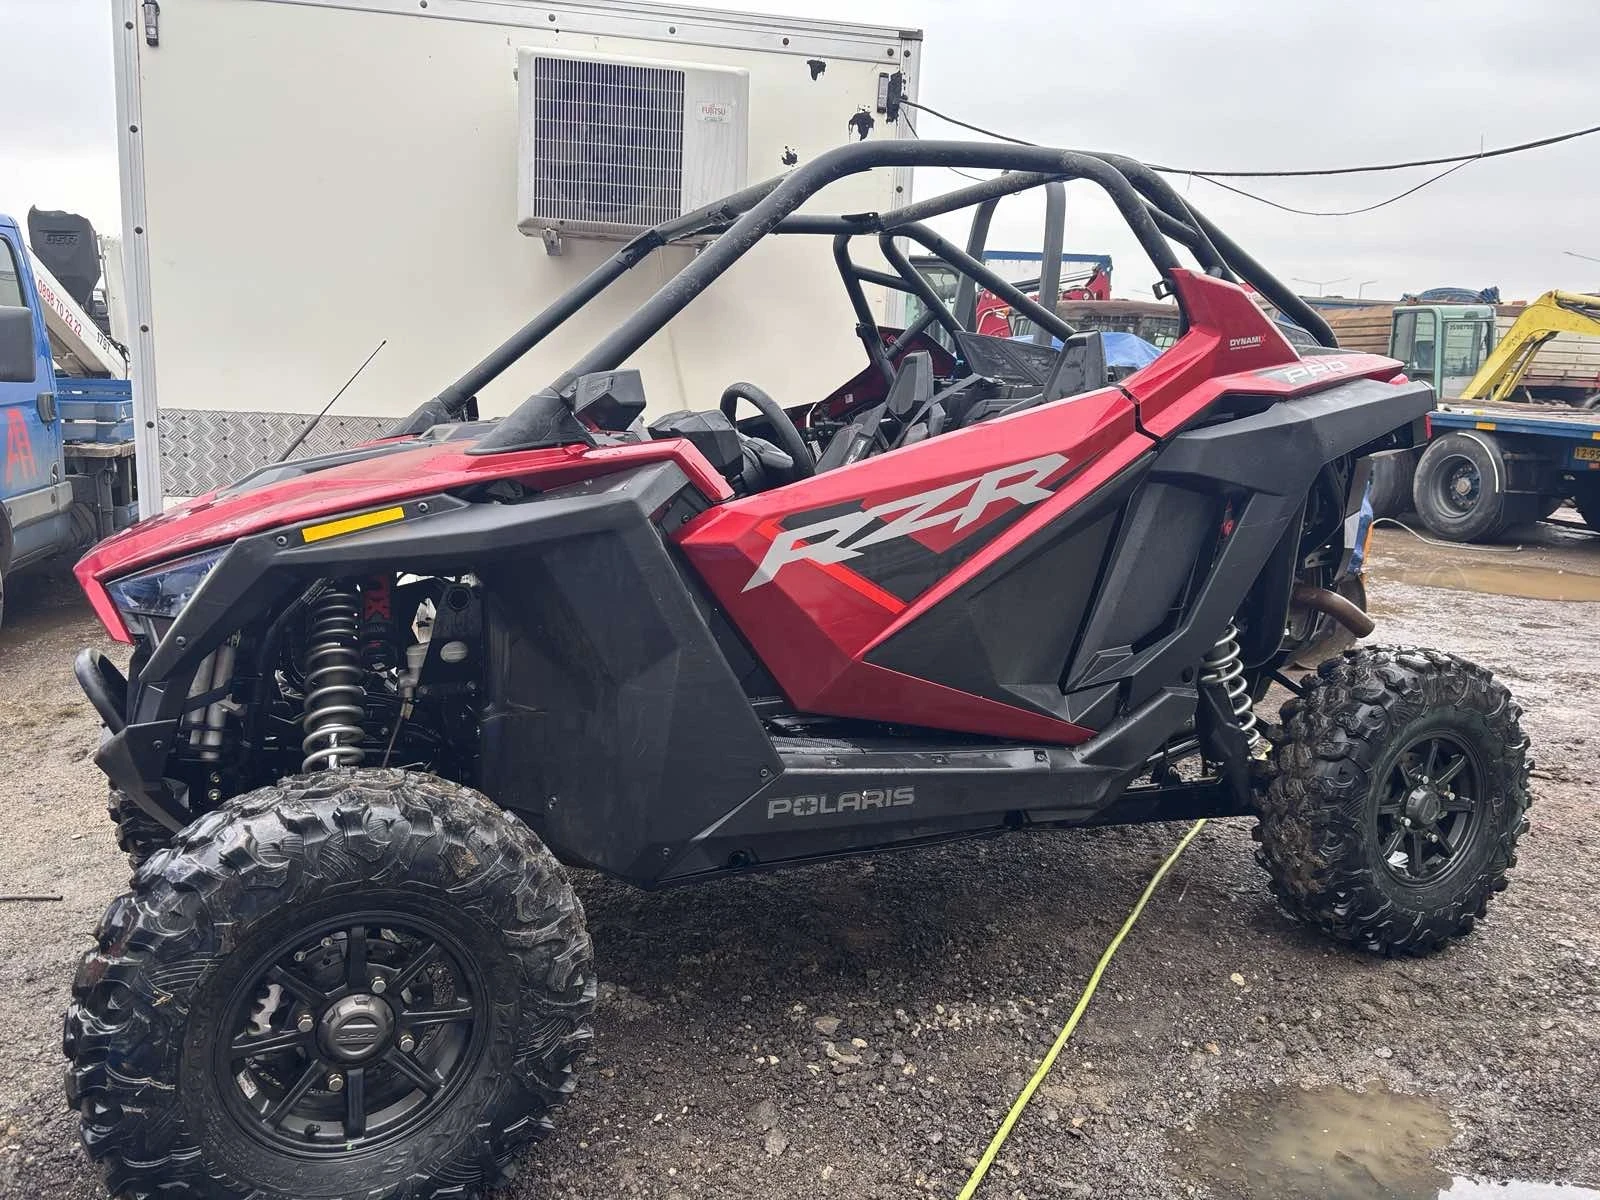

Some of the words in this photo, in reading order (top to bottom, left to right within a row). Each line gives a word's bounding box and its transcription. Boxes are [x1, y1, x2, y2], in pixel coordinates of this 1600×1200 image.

[702, 105, 726, 115] FUJITSU
[38, 279, 55, 307] 0898
[55, 298, 64, 319] 70
[64, 308, 73, 327] 22
[73, 317, 82, 337] 22
[1229, 334, 1266, 346] DYNAMIX
[1282, 361, 1346, 383] PRO
[741, 453, 1070, 592] RZR
[768, 787, 915, 819] POLARIS
